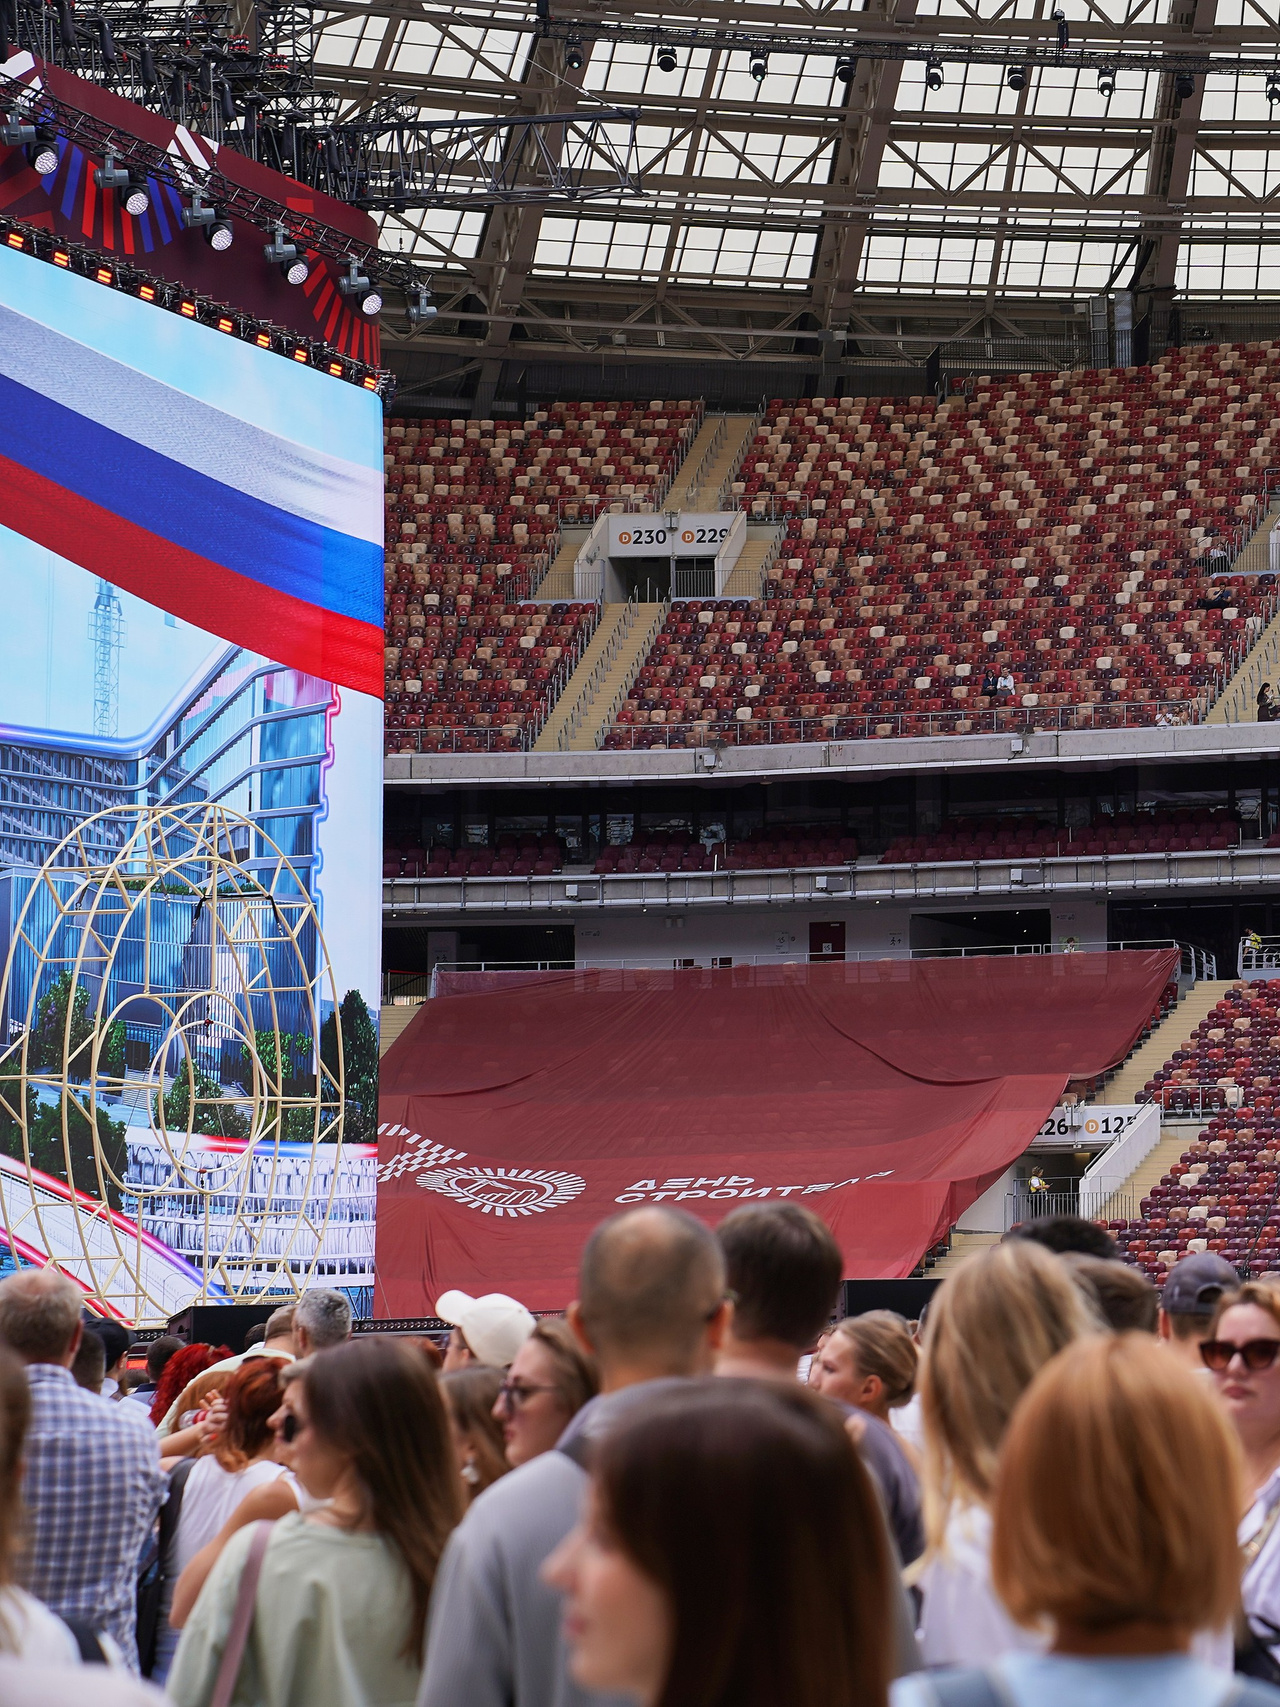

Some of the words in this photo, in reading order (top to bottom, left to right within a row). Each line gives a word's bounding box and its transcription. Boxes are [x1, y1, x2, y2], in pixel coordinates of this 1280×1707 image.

[632, 529, 667, 545] 230
[696, 528, 728, 544] 229
[1037, 1118, 1069, 1135] 26
[624, 1175, 755, 1191] ДЕНЬ
